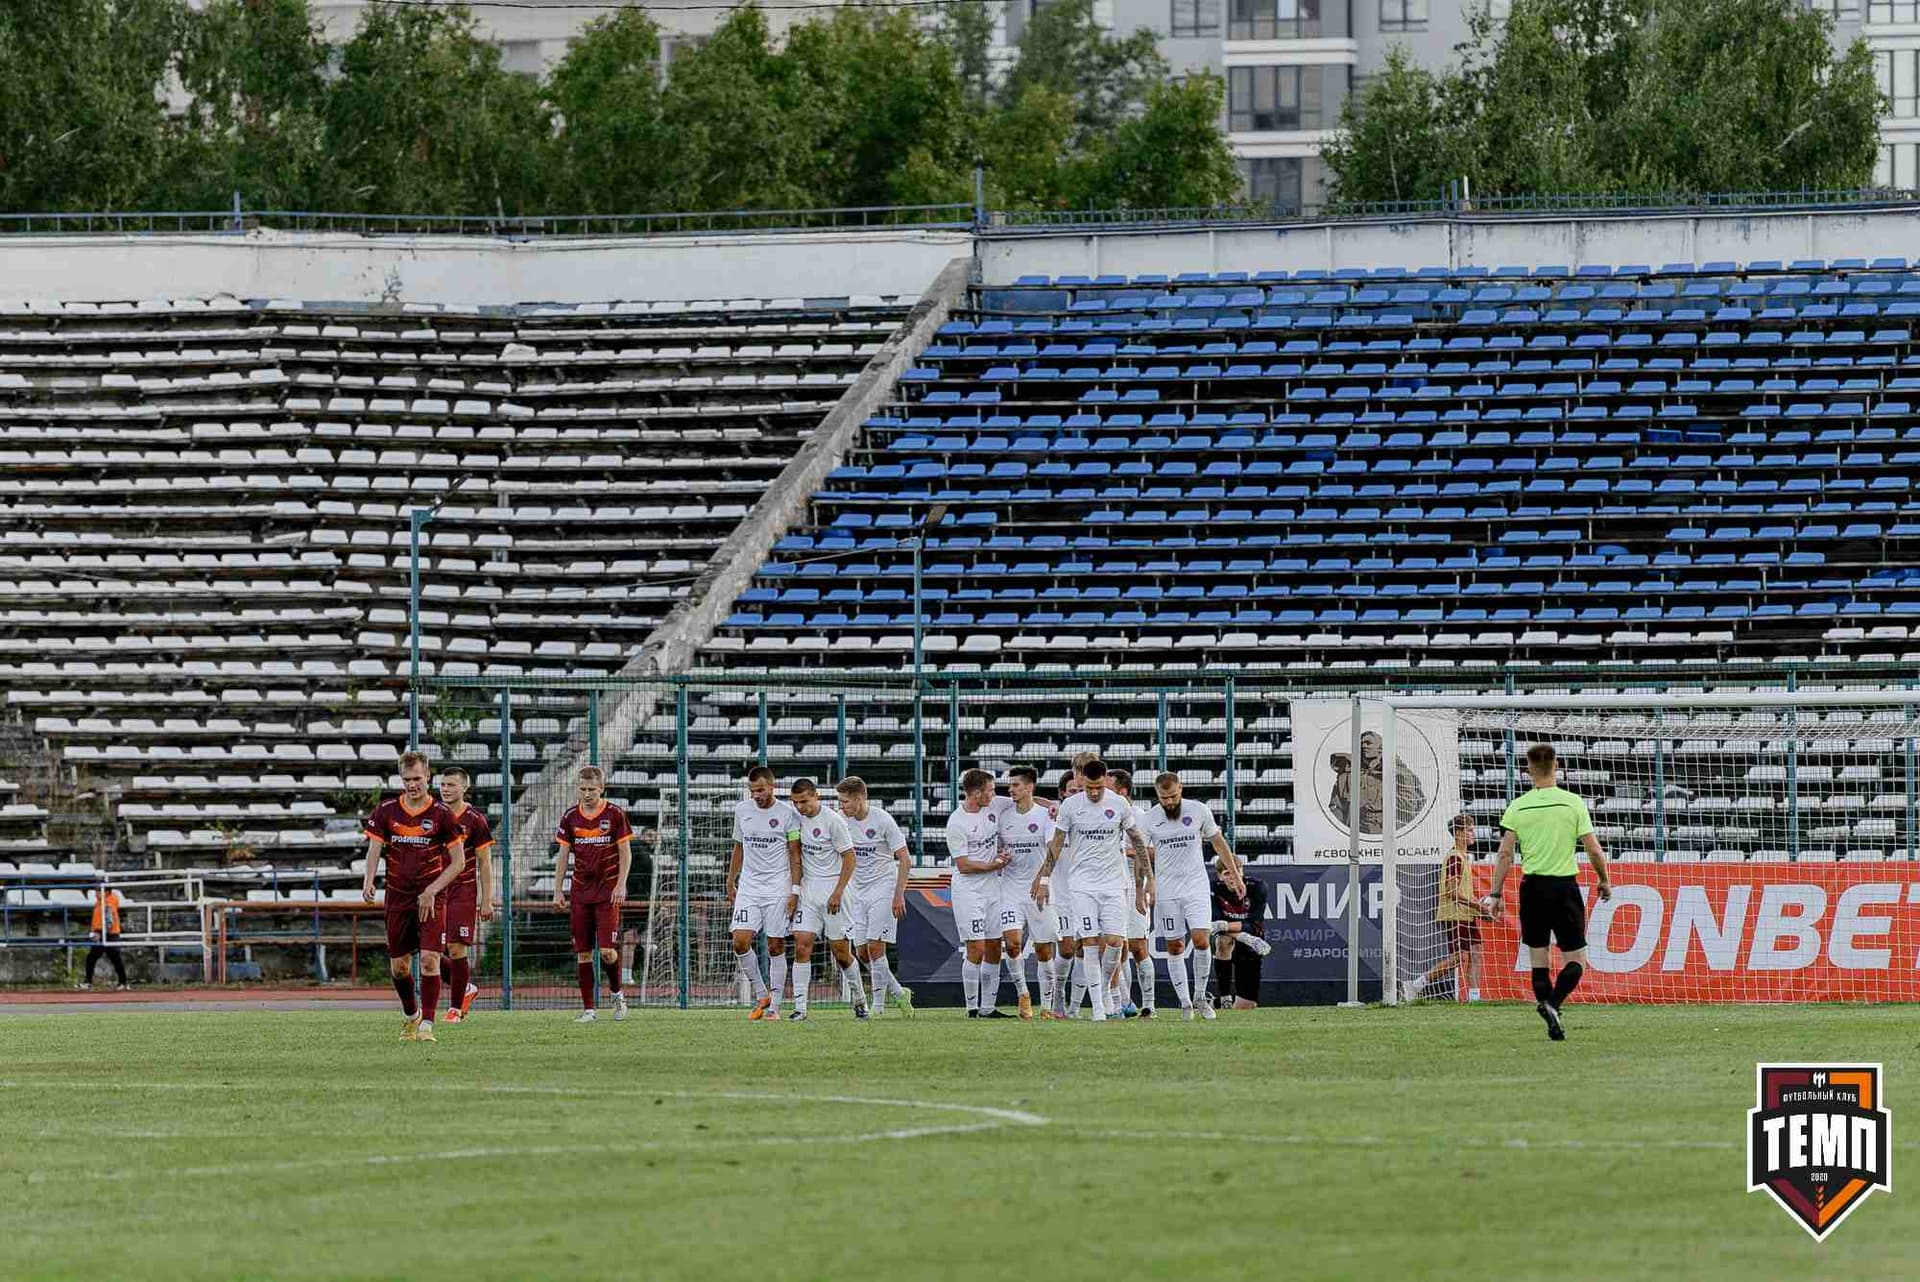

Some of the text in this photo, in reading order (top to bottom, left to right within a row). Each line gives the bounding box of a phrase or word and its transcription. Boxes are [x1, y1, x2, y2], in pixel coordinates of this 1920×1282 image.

[1314, 847, 1440, 859] #СВОХНЕОСАЕМ
[733, 909, 748, 923] 40
[999, 910, 1015, 925] 55
[1083, 916, 1093, 931] 9
[1162, 917, 1175, 931] 10
[1515, 884, 1920, 973] ONBE
